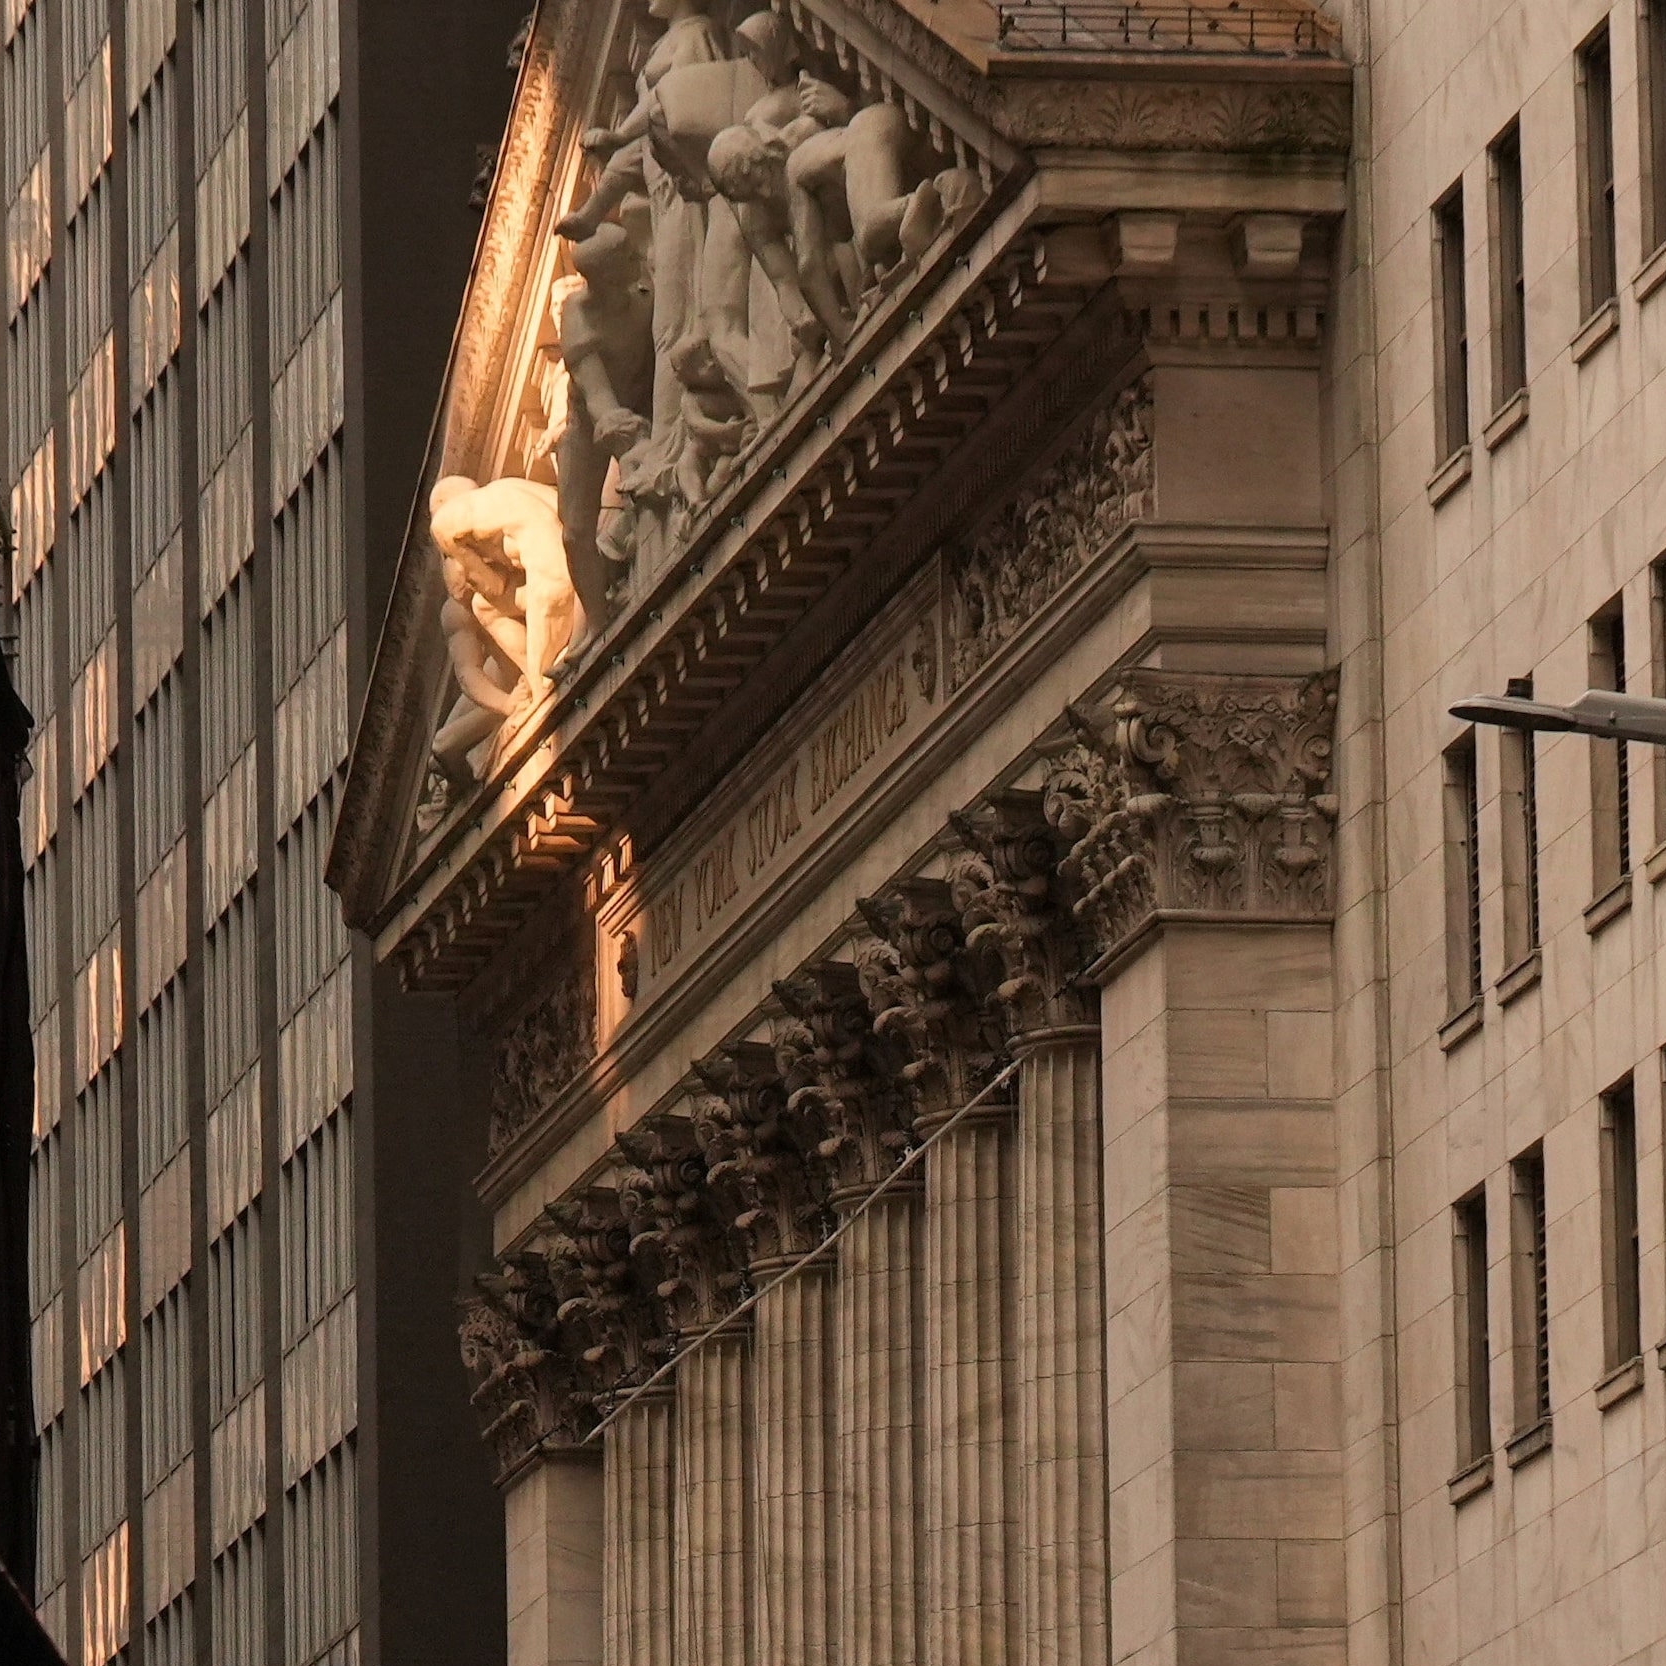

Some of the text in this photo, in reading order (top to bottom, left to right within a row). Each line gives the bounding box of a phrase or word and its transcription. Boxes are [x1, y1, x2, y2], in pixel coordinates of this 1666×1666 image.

[650, 648, 907, 978] NEW YORK STOCK EXCHANGE
